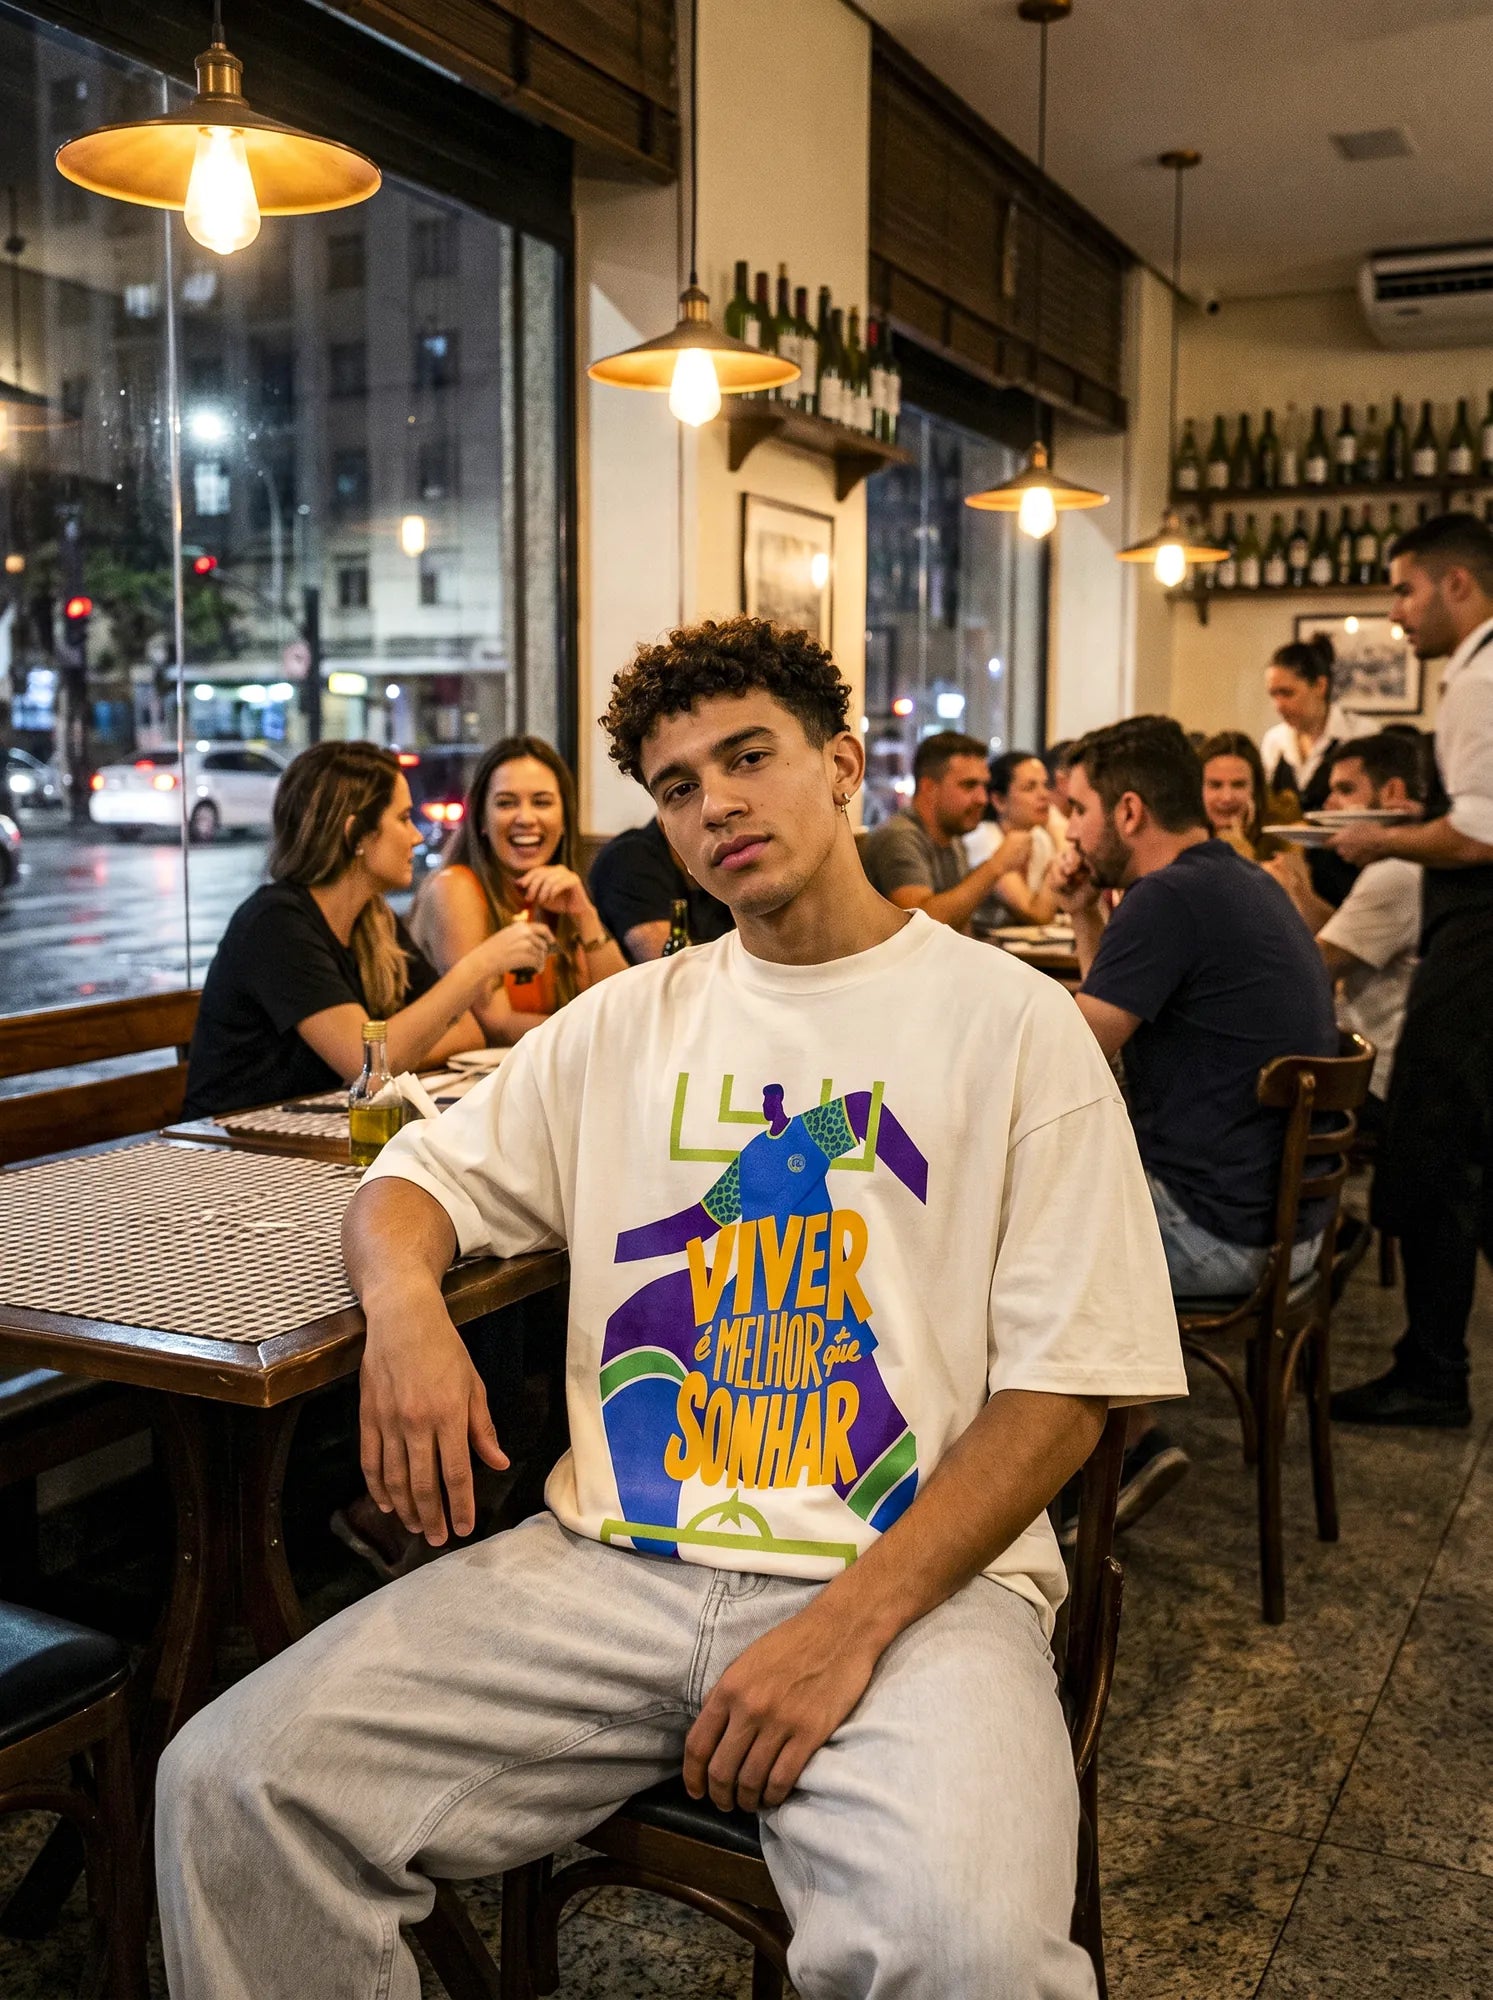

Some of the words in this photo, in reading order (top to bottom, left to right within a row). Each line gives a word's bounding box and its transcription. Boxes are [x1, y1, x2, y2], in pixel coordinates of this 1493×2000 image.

[686, 1208, 874, 1328] VIVER
[694, 1325, 713, 1361] é
[712, 1311, 825, 1391] MELHOR
[664, 1371, 860, 1490] SONHAR
